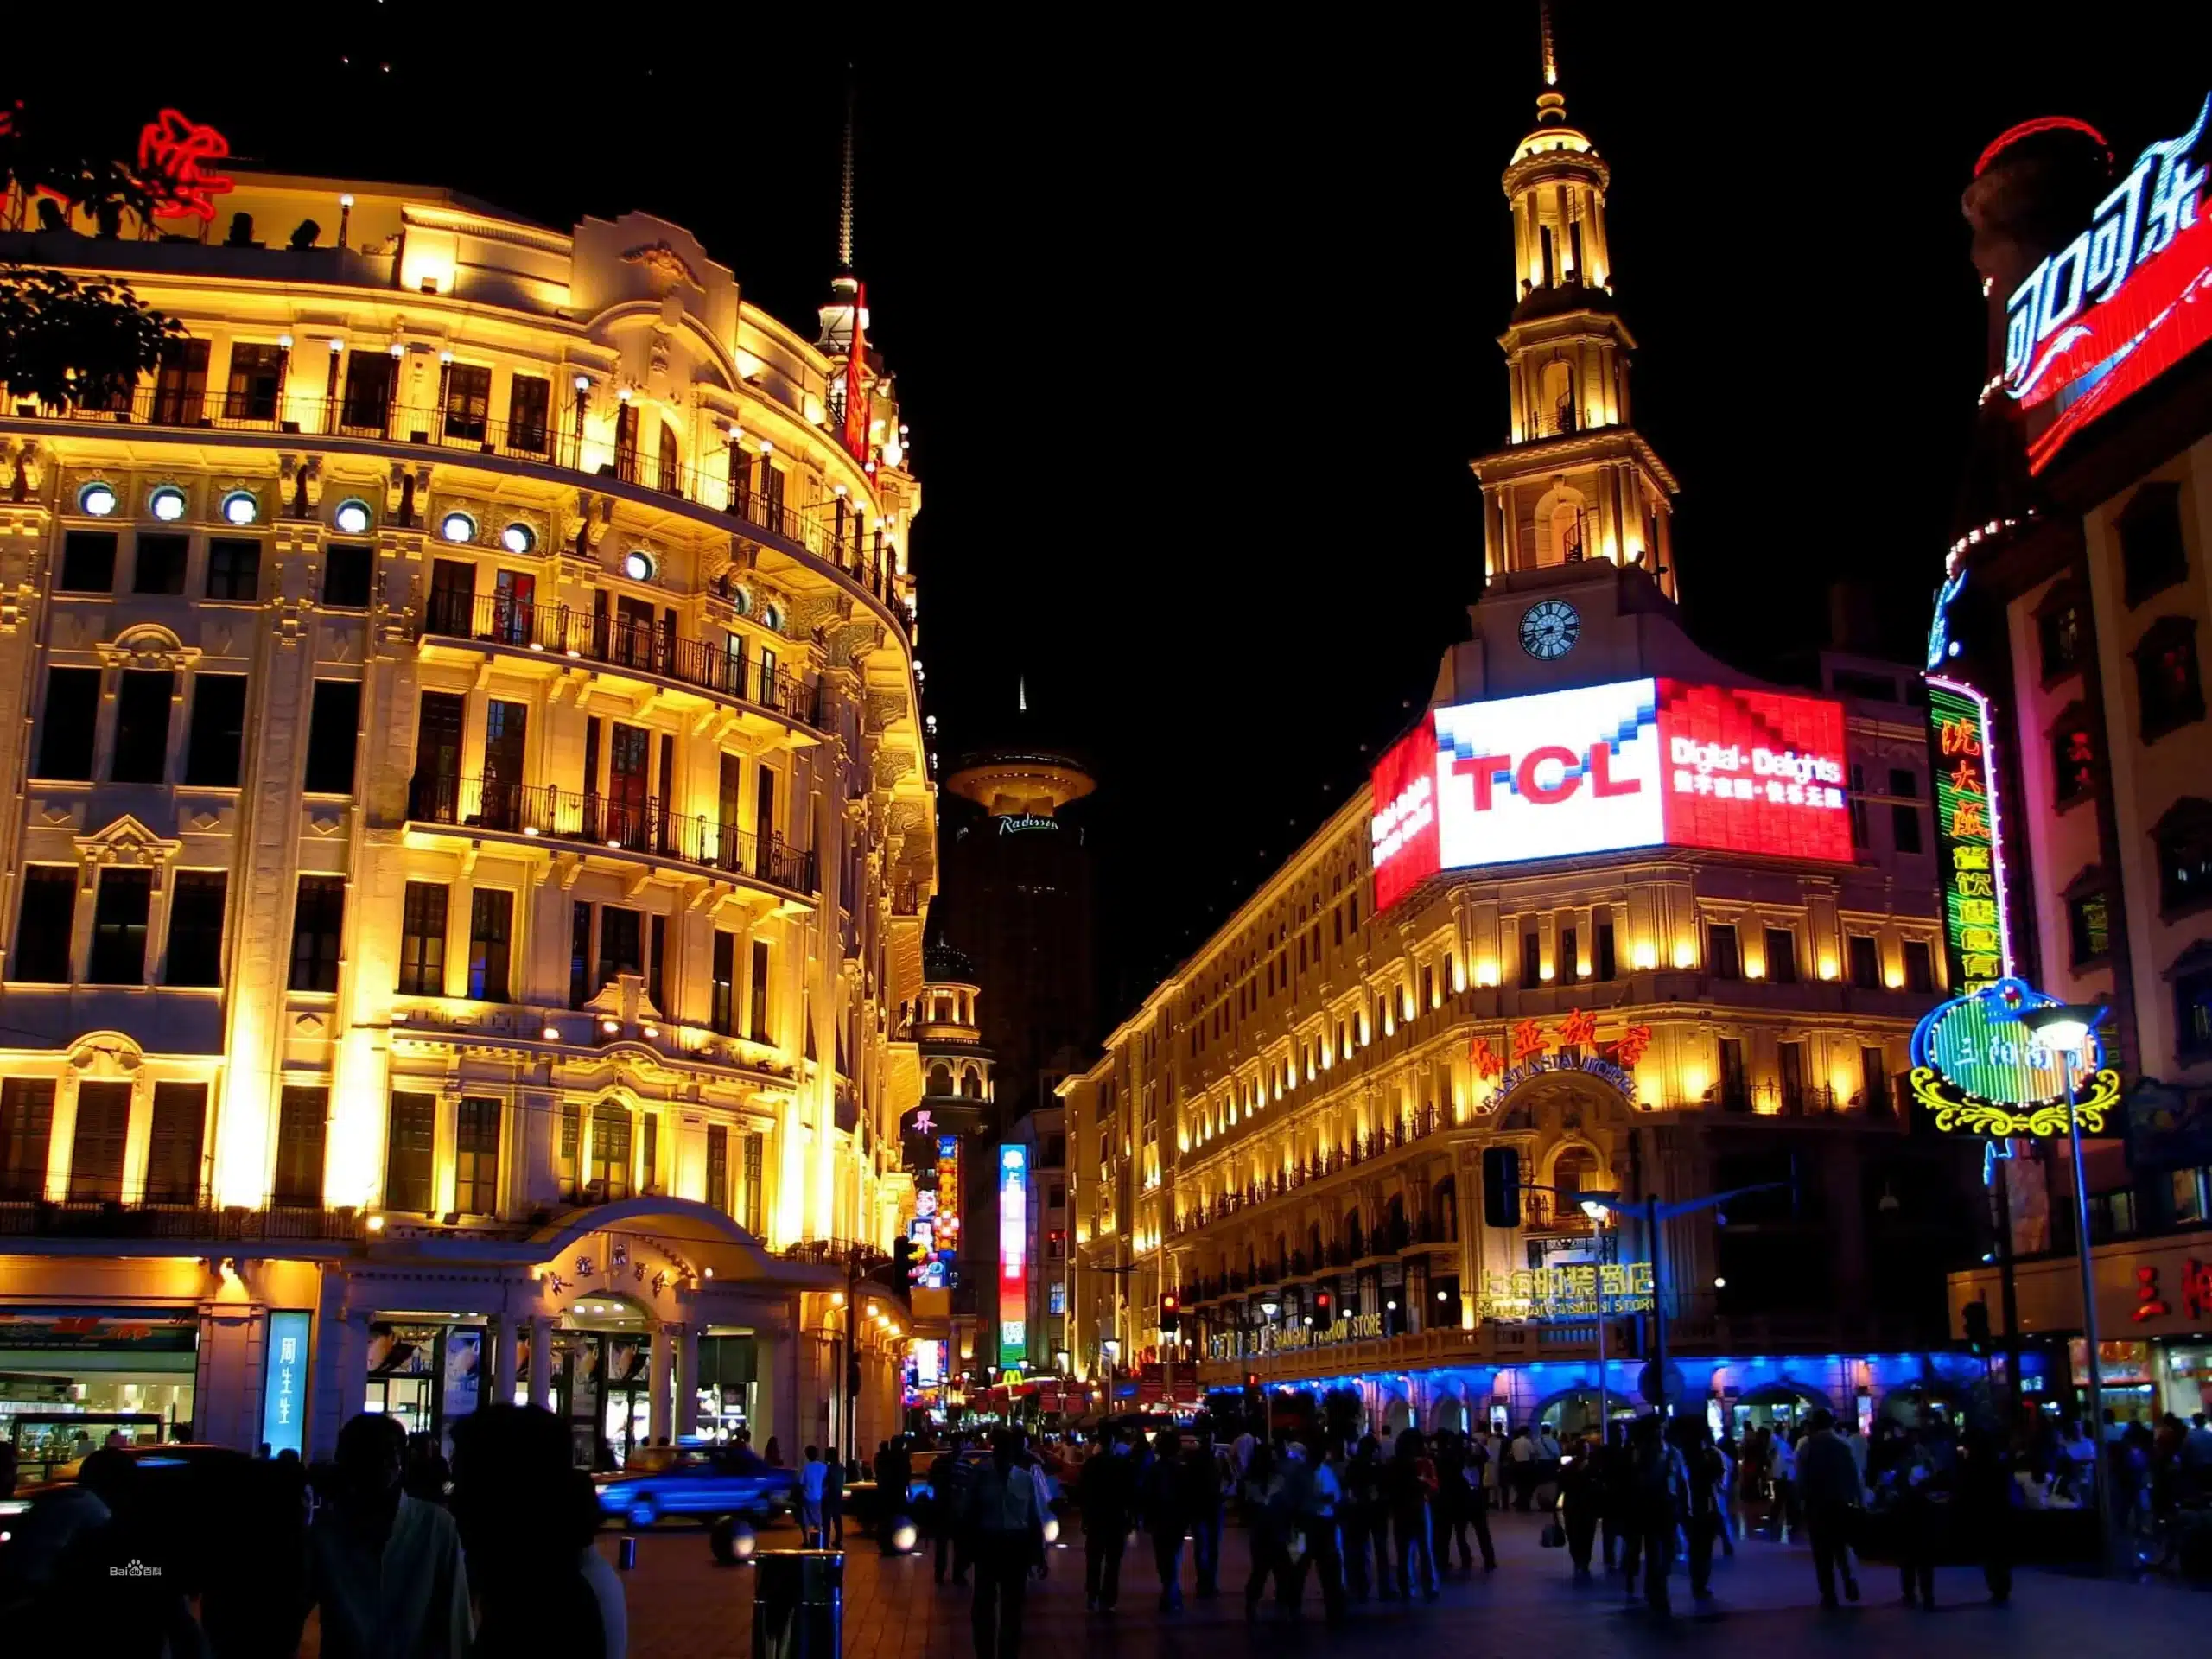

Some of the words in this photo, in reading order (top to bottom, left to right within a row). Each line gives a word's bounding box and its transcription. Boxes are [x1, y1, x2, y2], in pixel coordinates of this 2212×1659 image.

[2006, 90, 2212, 399] 可口可乐
[1452, 741, 1641, 811] TCL
[999, 813, 1059, 836] Radisson
[1483, 1066, 1525, 1112] EAST
[1529, 1053, 1573, 1076] ASIA
[1583, 1055, 1638, 1103] HOTEL
[1274, 1325, 1311, 1349] SHANGHAI
[1352, 1313, 1382, 1337] STORE
[278, 1338, 296, 1424] 周生生
